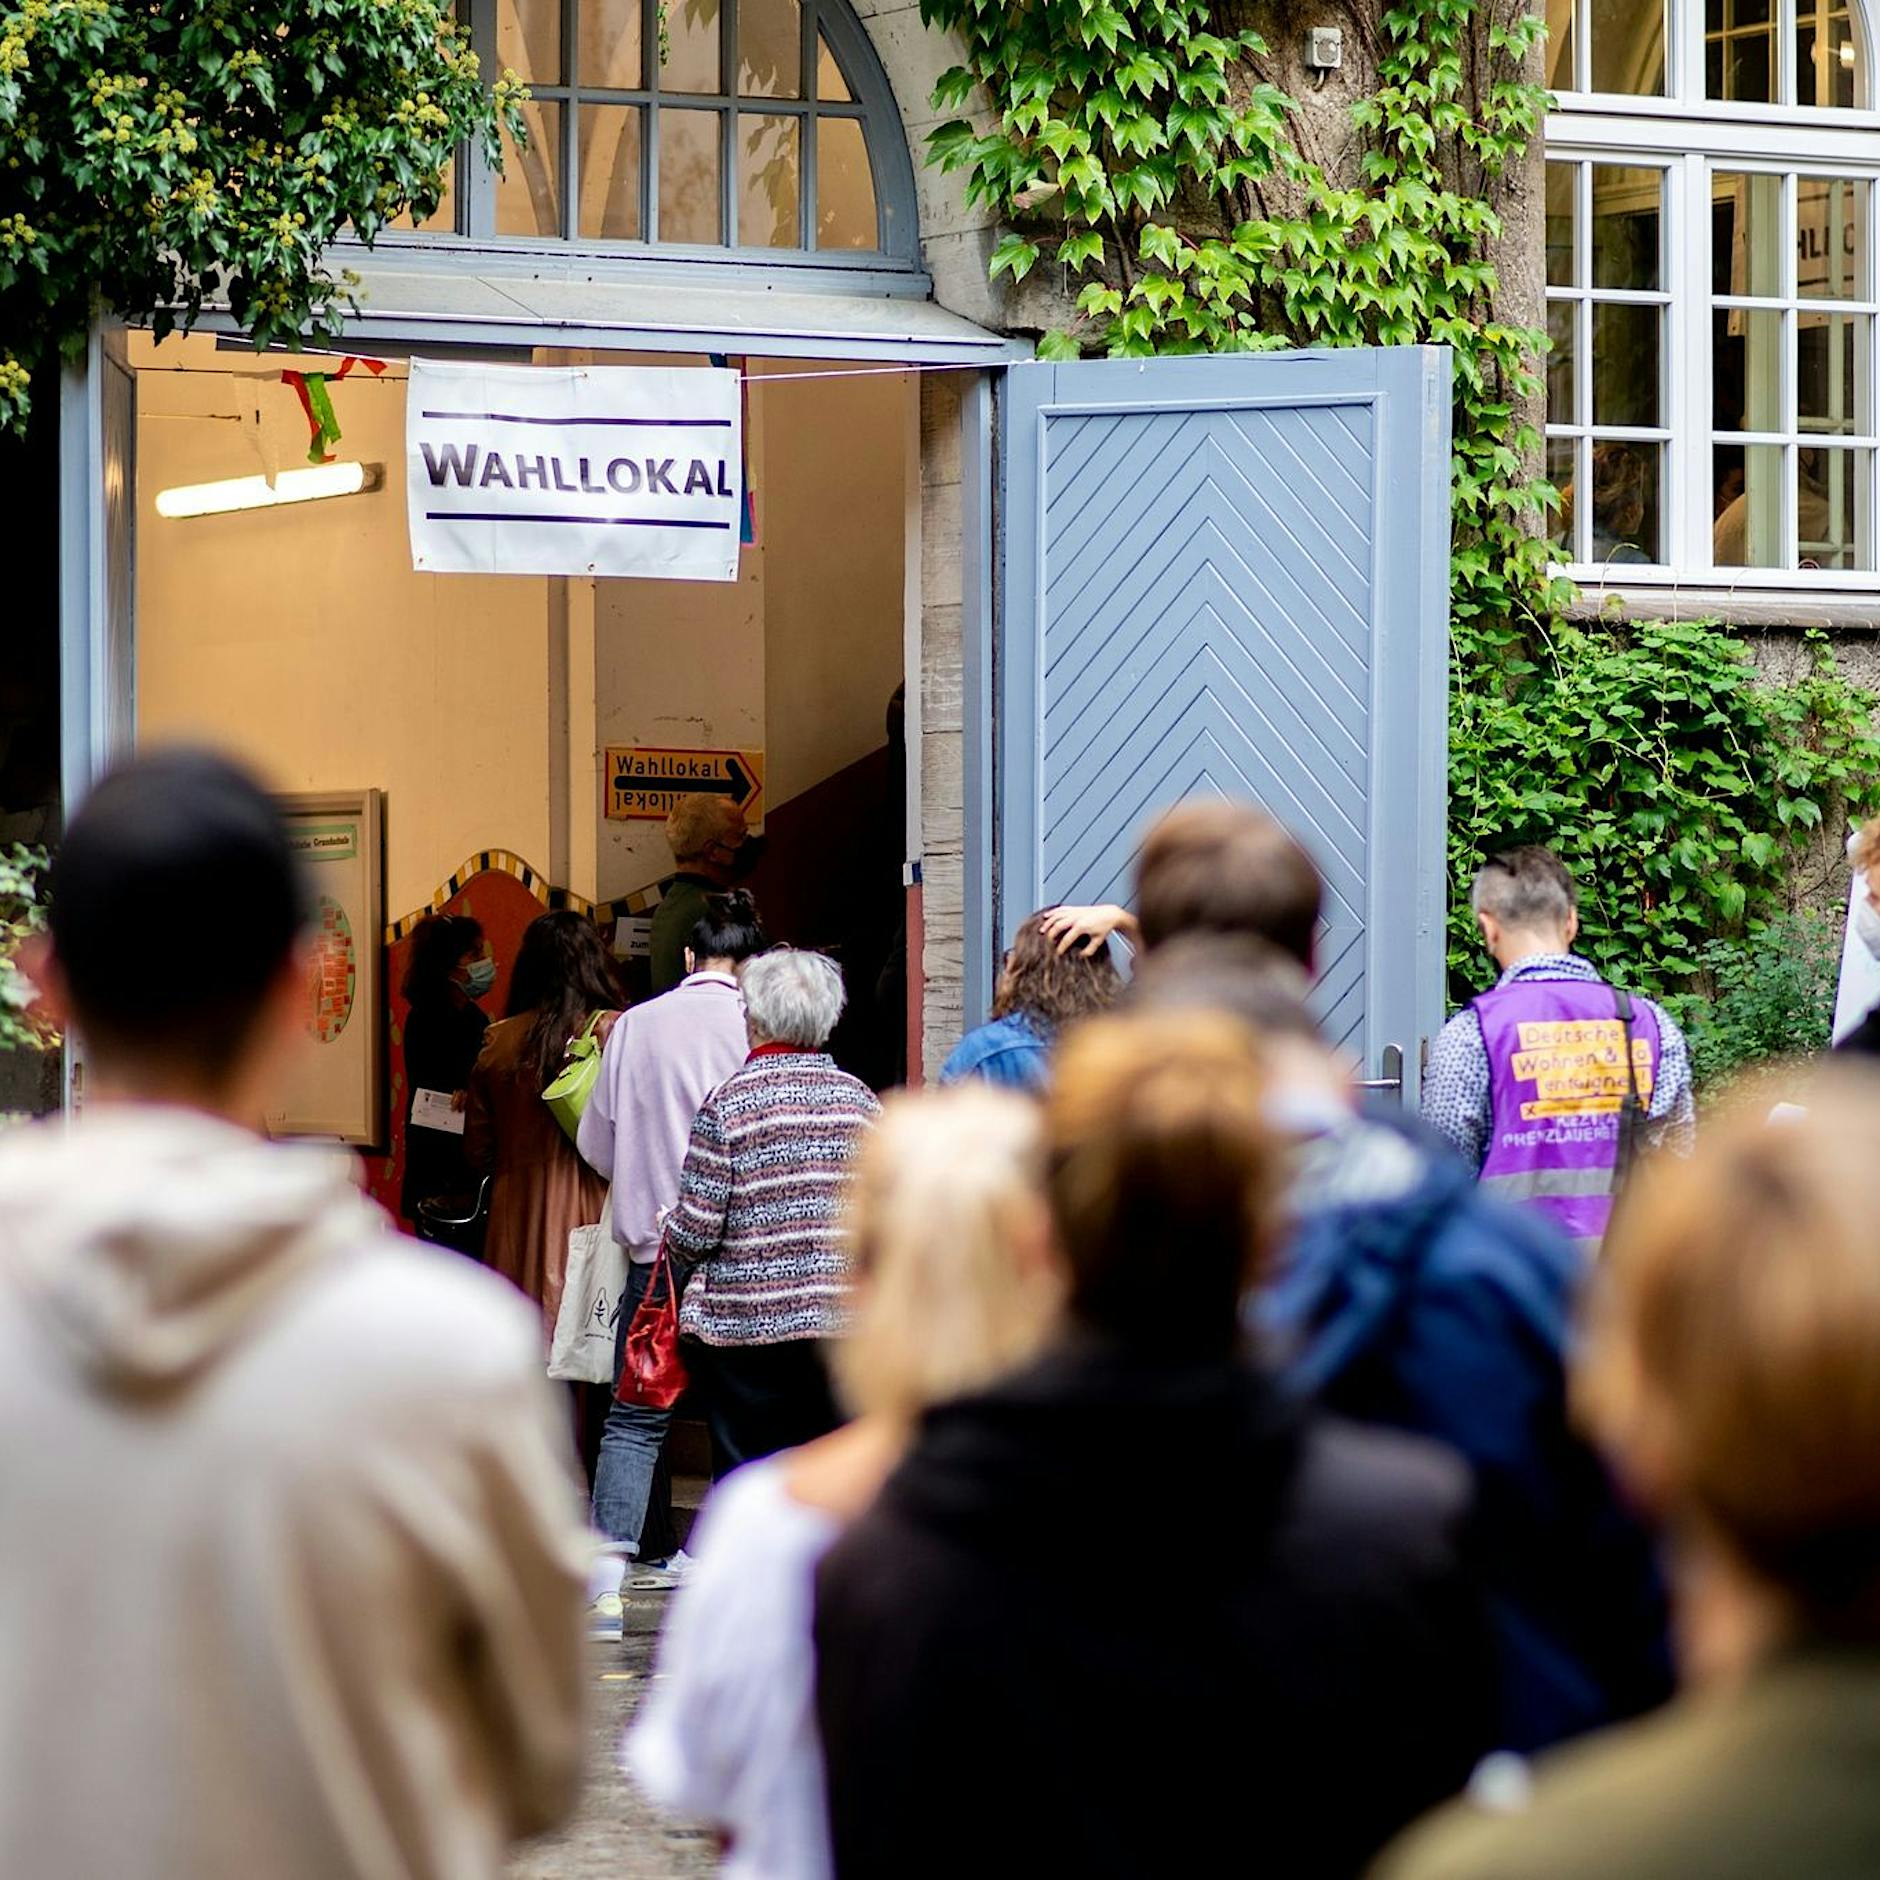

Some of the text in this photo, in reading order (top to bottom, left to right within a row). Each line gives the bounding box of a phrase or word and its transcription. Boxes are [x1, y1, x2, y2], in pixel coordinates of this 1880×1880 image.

[420, 442, 734, 497] WAHLLOKAL
[616, 755, 720, 777] Wahllokal
[1525, 1026, 1620, 1045] Deutsche
[1518, 1052, 1599, 1073] Wohnen
[1604, 1046, 1618, 1064] &
